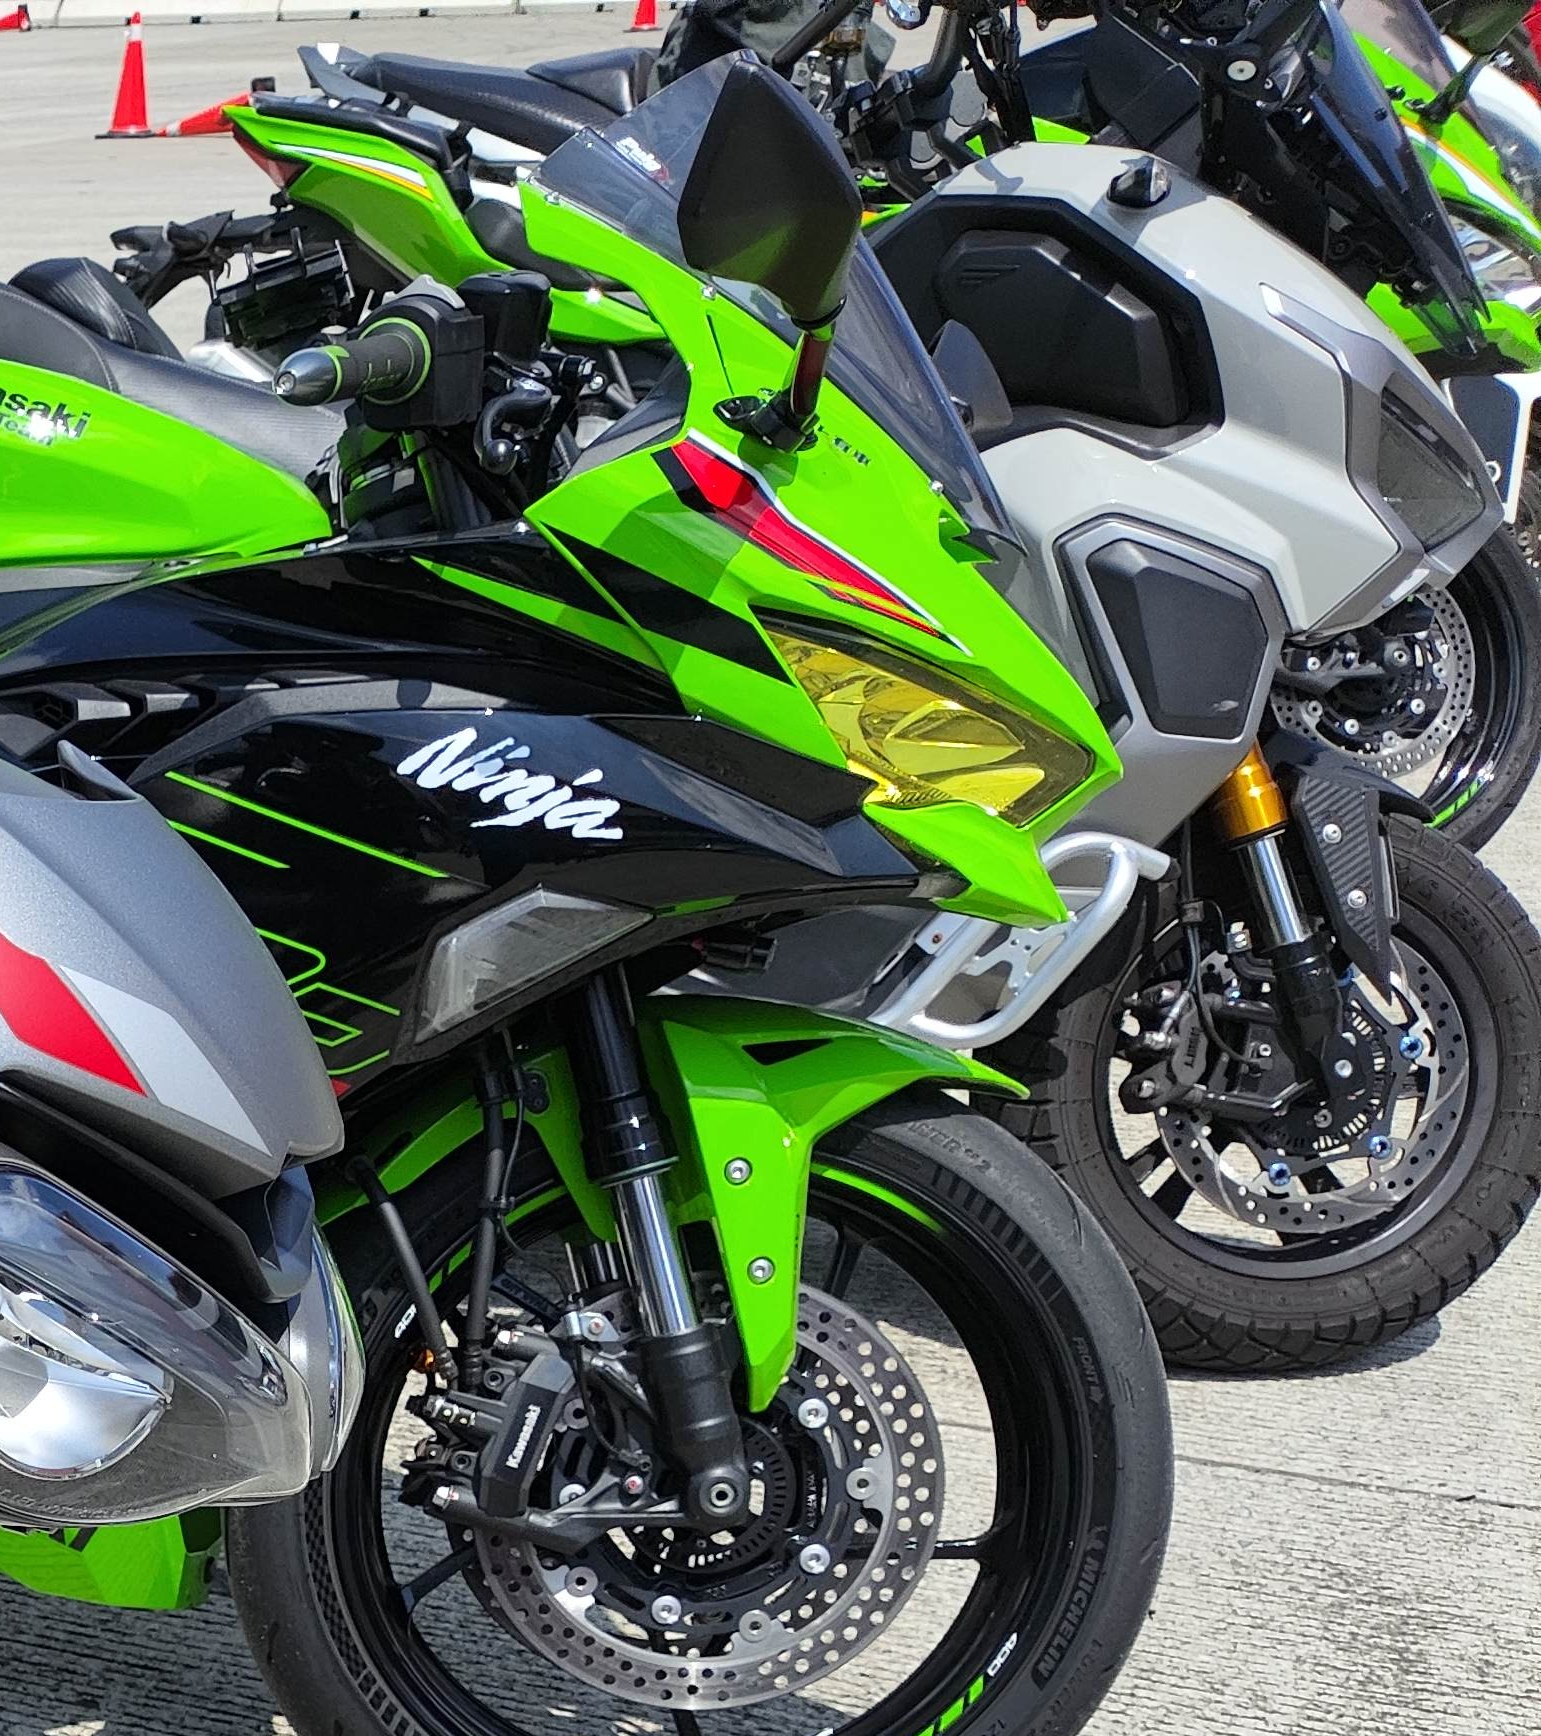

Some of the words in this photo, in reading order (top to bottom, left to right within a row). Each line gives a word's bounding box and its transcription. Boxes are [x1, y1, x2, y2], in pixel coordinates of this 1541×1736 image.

[397, 727, 623, 839] Ninja
[505, 1403, 541, 1469] Kawasaki
[1038, 1555, 1101, 1678] MICHELIN
